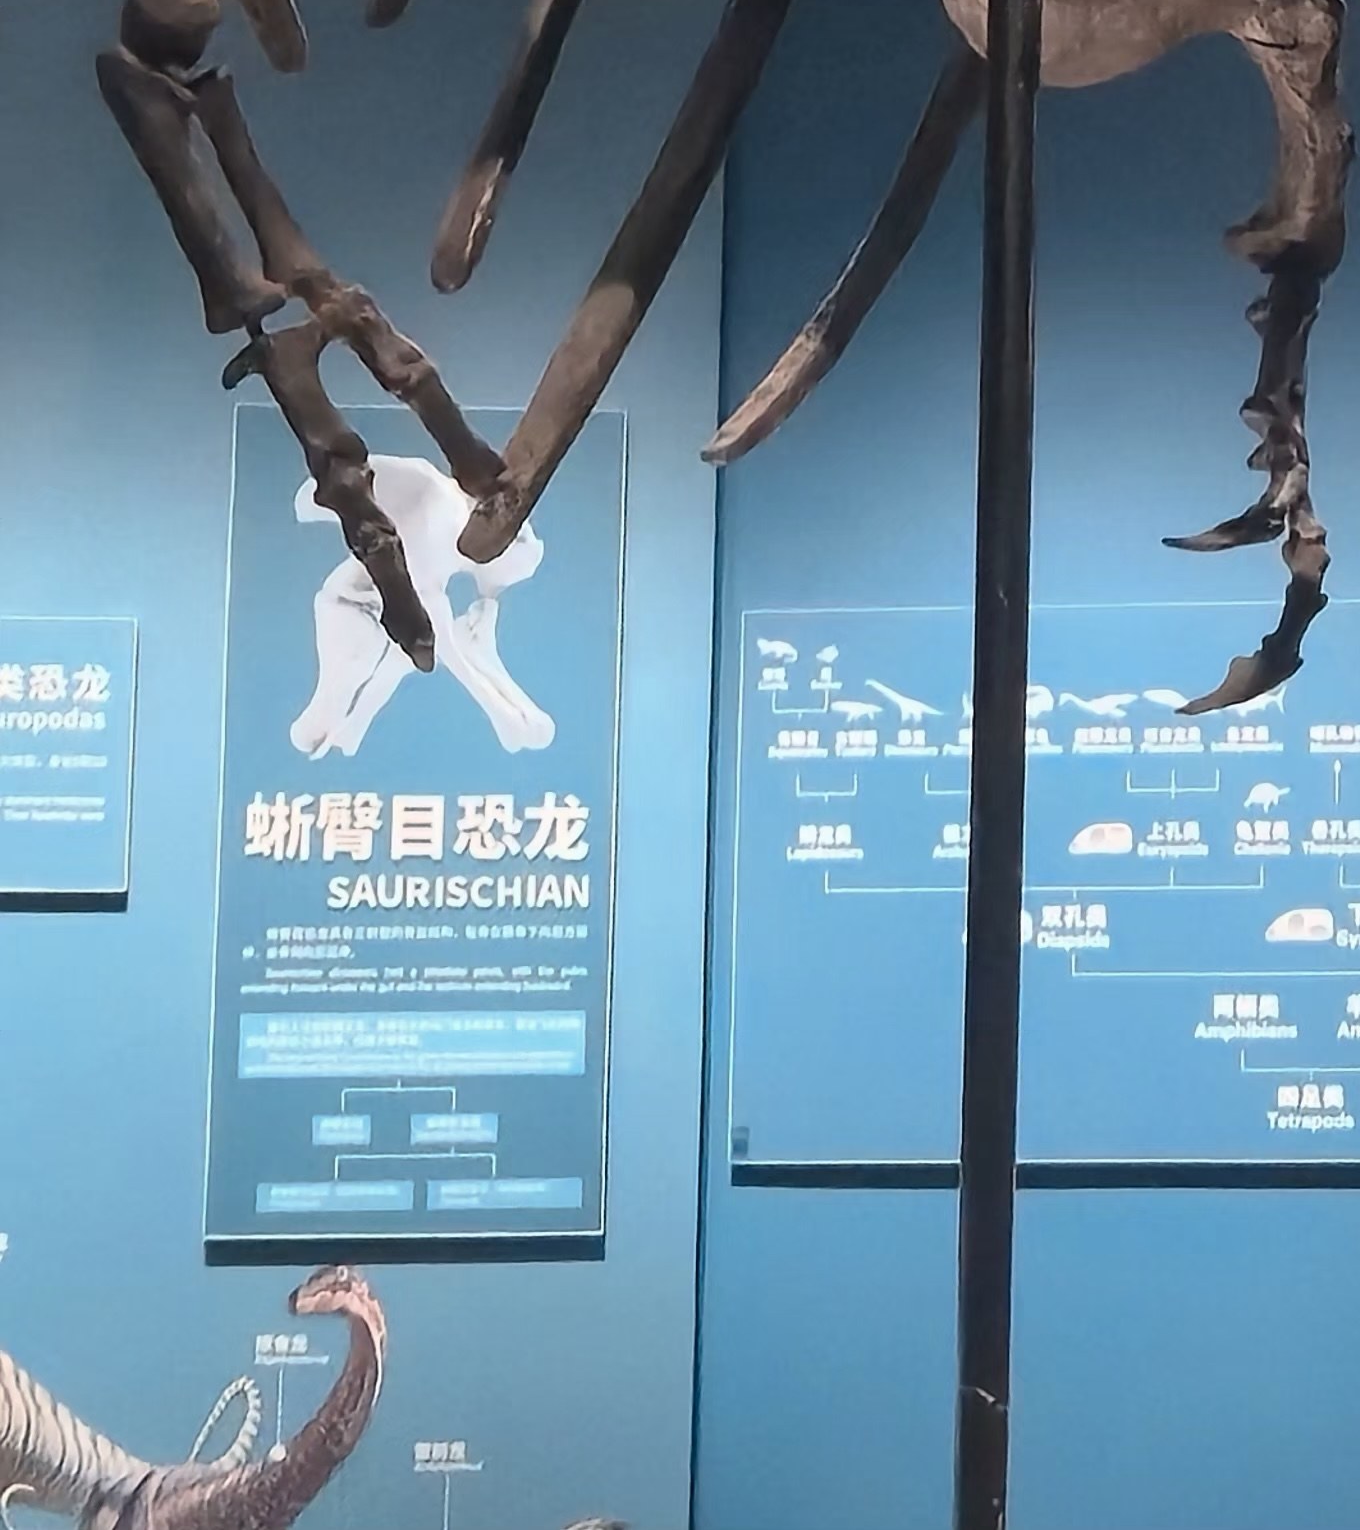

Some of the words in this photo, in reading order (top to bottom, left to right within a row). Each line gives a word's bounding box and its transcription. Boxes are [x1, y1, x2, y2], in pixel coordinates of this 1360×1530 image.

[244, 792, 590, 861] 蜥臀目恐龙
[327, 873, 590, 908] SAURISCHIAN
[1194, 1021, 1298, 1042] Amphibians
[1267, 1111, 1355, 1133] Tetrapods
